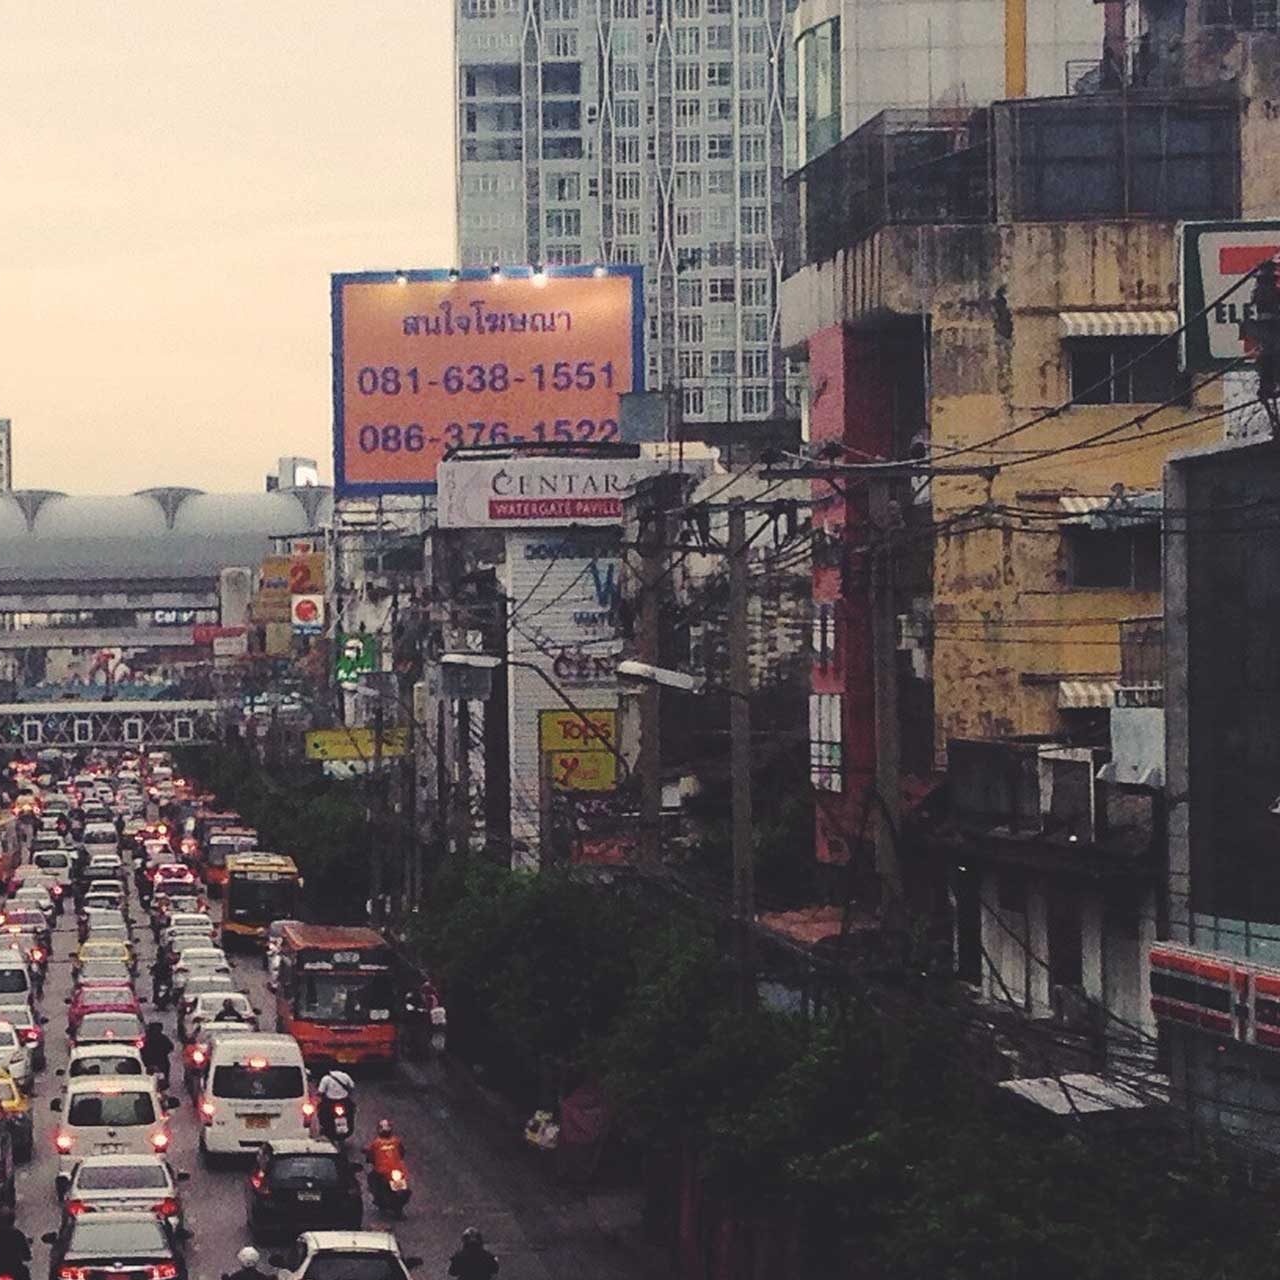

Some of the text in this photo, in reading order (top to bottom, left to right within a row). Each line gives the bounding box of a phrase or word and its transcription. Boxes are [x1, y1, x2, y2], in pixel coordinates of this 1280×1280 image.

[402, 300, 572, 336] สนใจโฆษณา
[1215, 303, 1258, 324] ELE
[357, 361, 615, 396] 081-638-1551
[358, 419, 619, 453] 086-376-1522
[496, 501, 571, 516] WATERGATE
